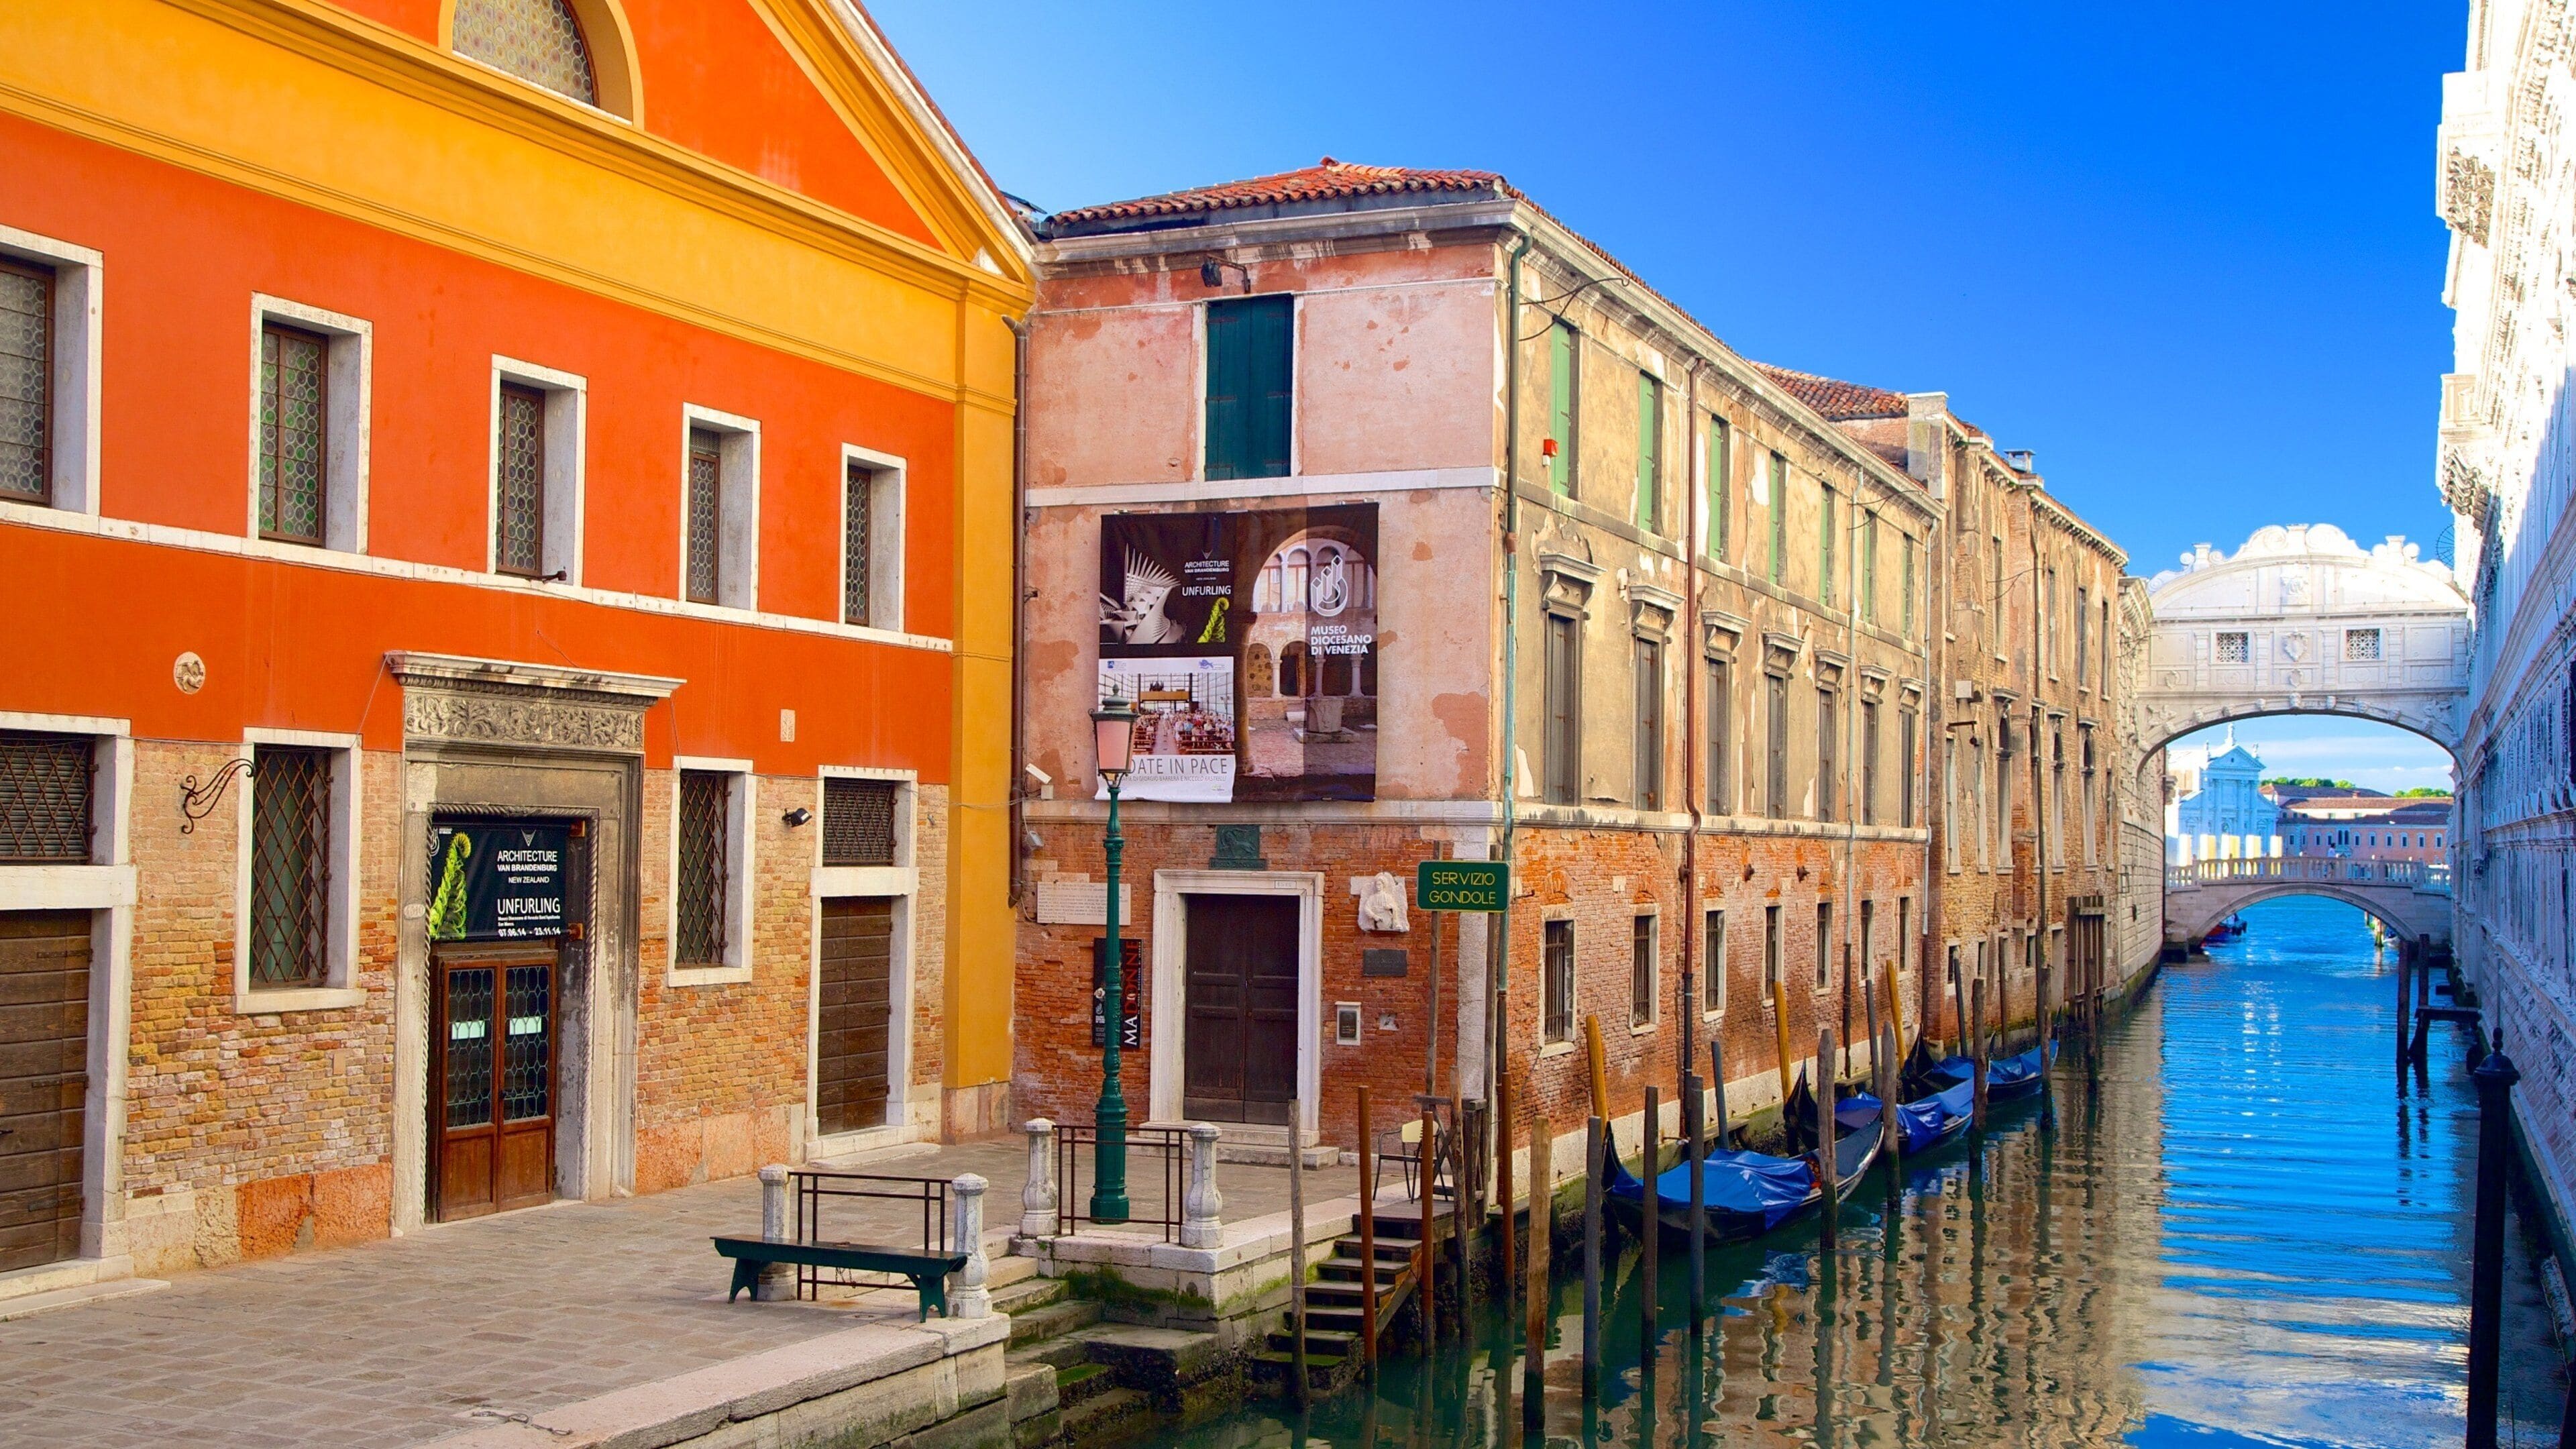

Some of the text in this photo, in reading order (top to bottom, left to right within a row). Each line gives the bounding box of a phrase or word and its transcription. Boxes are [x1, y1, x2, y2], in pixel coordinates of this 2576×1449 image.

[1184, 560, 1230, 568] ARCHITECTURE
[1182, 585, 1232, 596] UNFURLING
[1311, 625, 1347, 635] MUSEO
[1311, 635, 1372, 645] DIOCESANO
[1311, 645, 1368, 655] DI VENEZIA
[1130, 757, 1227, 774] DATE IN PACE
[497, 850, 558, 862] ARCHITECTURE
[497, 863, 558, 872] VAN BRANDENBURG
[1432, 871, 1495, 885] SERVIZIO
[1429, 890, 1496, 904] GONDOLE
[497, 898, 561, 914] UNFURLING
[534, 926, 561, 936] 23.11.14
[1124, 941, 1139, 1046] MADONNE
